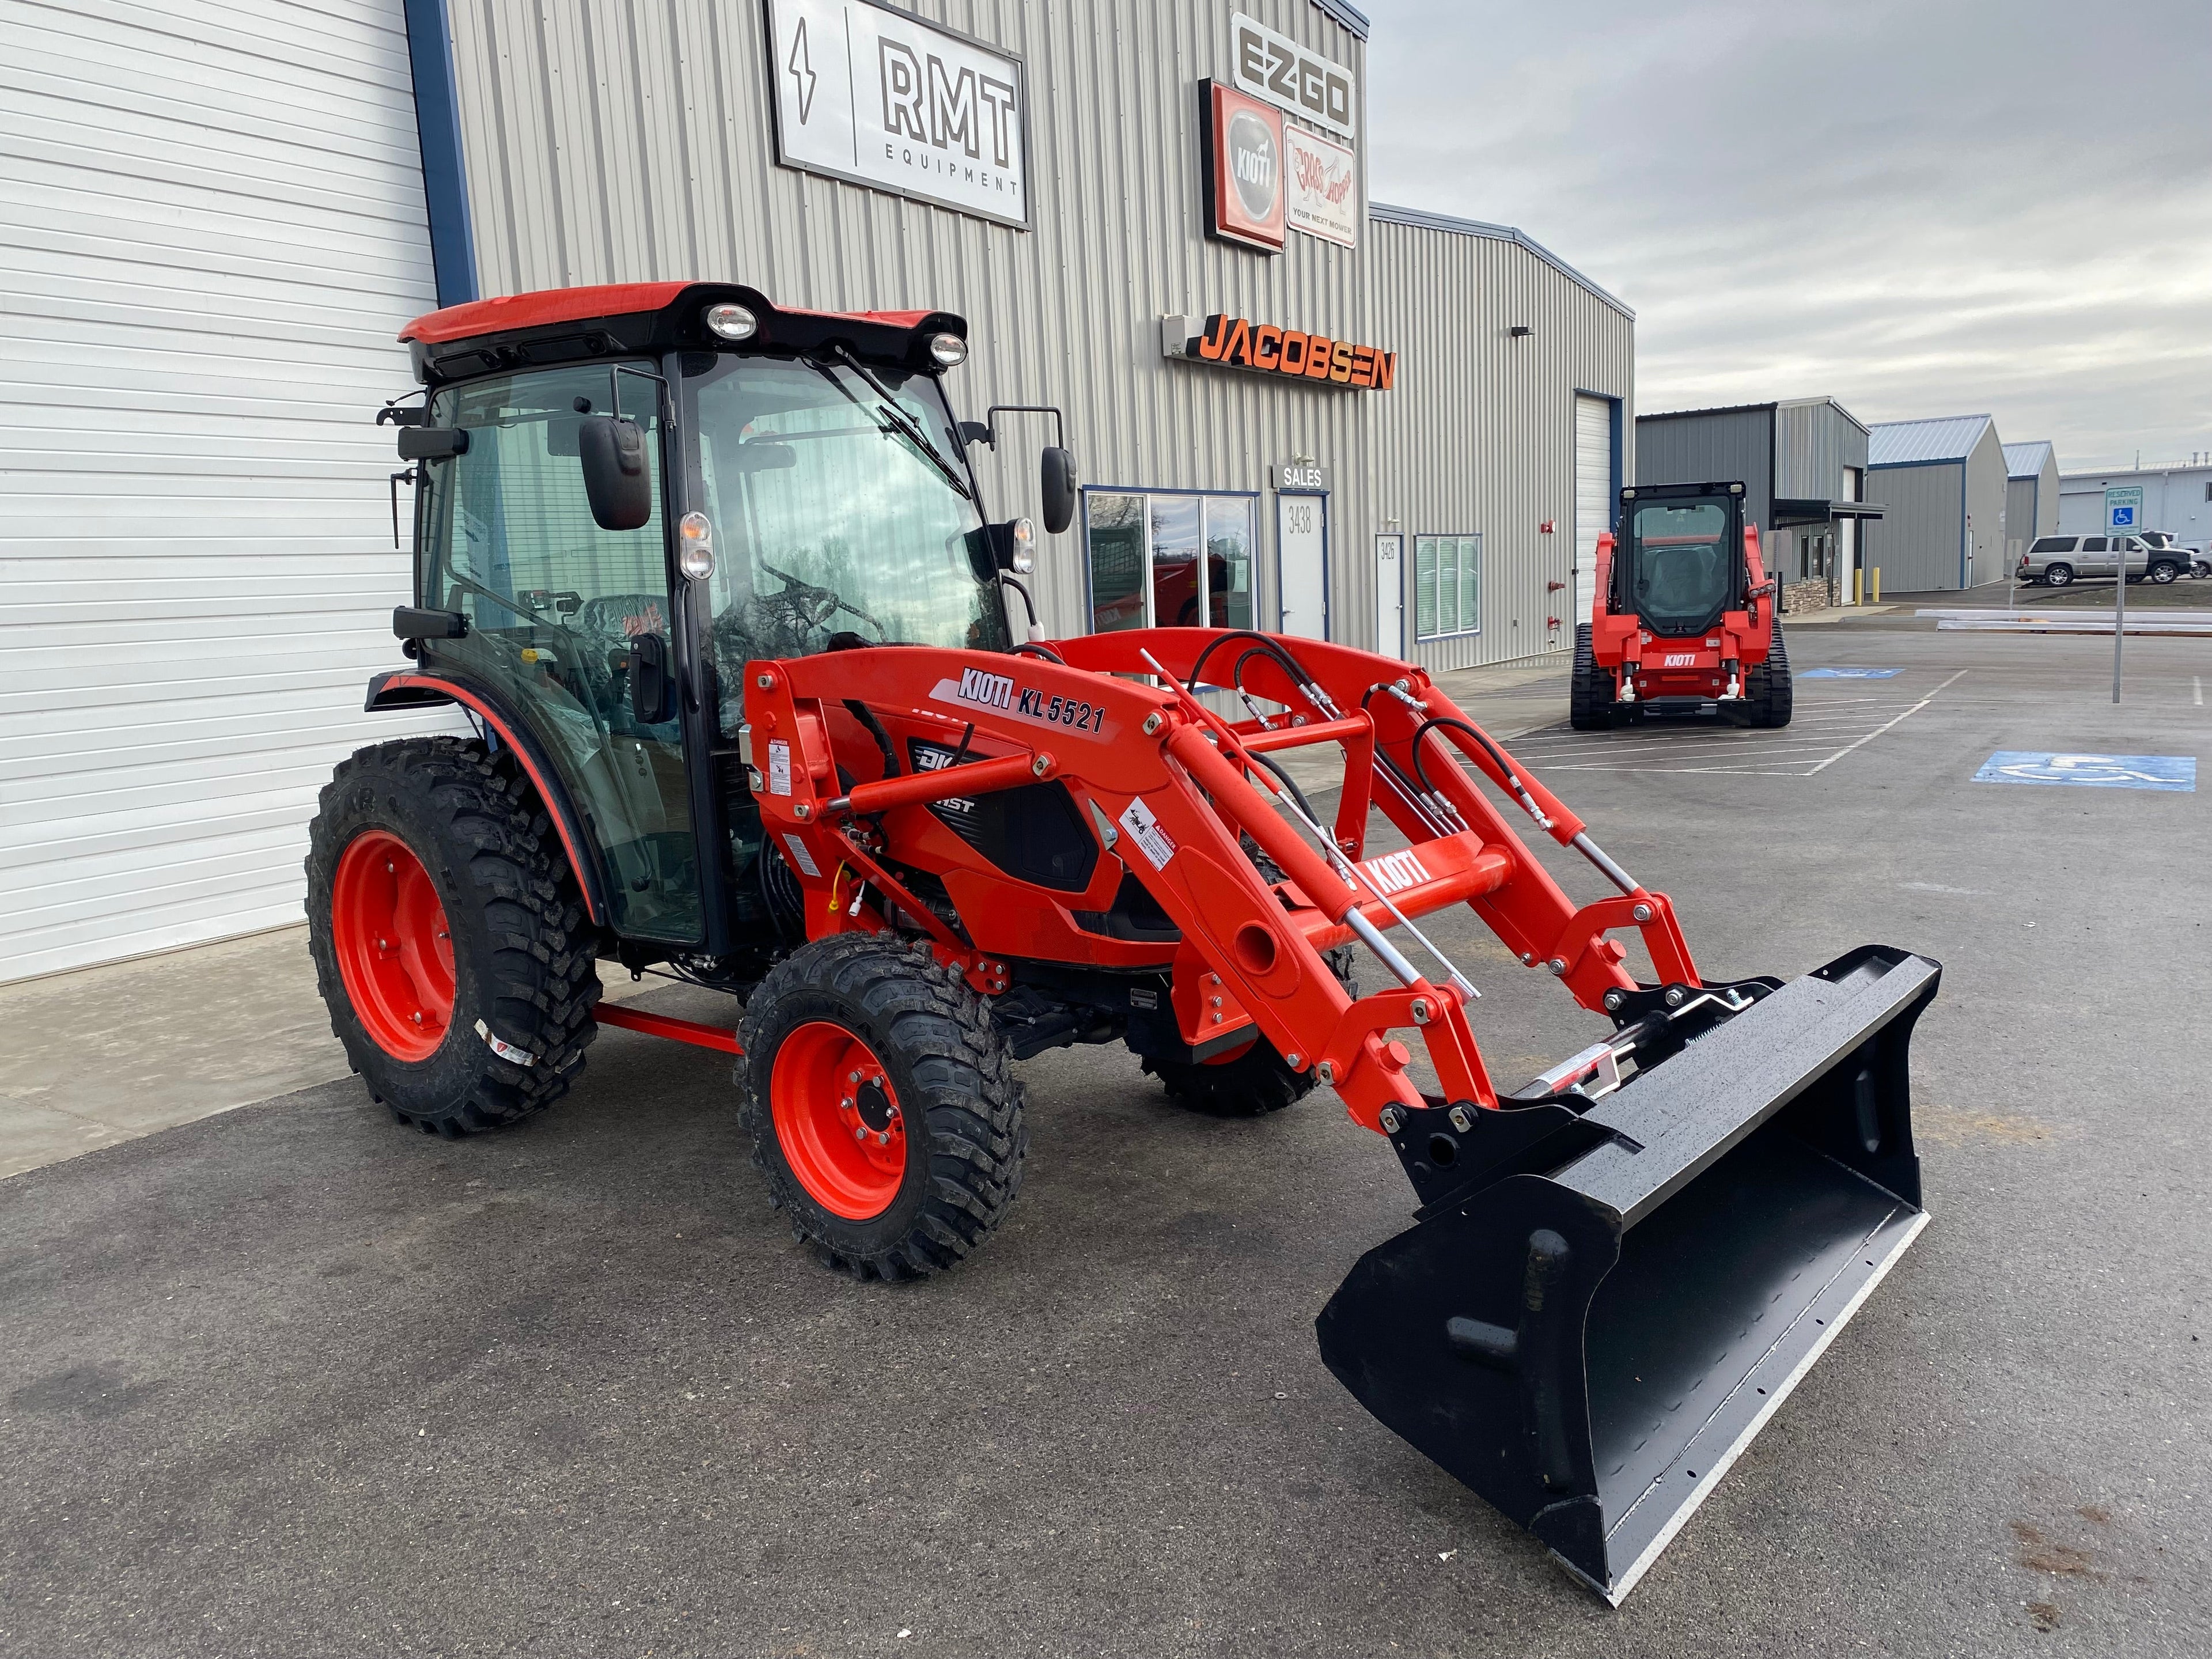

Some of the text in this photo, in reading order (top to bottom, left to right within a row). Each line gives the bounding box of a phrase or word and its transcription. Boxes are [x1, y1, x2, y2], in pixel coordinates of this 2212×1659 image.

[1240, 26, 1350, 126] EZGO
[878, 35, 1015, 168] RMT
[885, 143, 1017, 195] EQUIPMENT
[1237, 146, 1271, 188] KIOTI
[1293, 207, 1352, 234] YOUR NEXT MOWER
[1199, 314, 1397, 391] JACOBSEN
[1283, 467, 1321, 487] SALES
[2108, 490, 2141, 498] RESERVED
[1289, 505, 1312, 534] 3438
[1381, 542, 1395, 560] 3426
[1664, 654, 1696, 667] KIOTI
[958, 666, 1015, 710] KIOTI
[1158, 828, 1176, 850] DANGER
[1365, 850, 1432, 894] KIOTI
